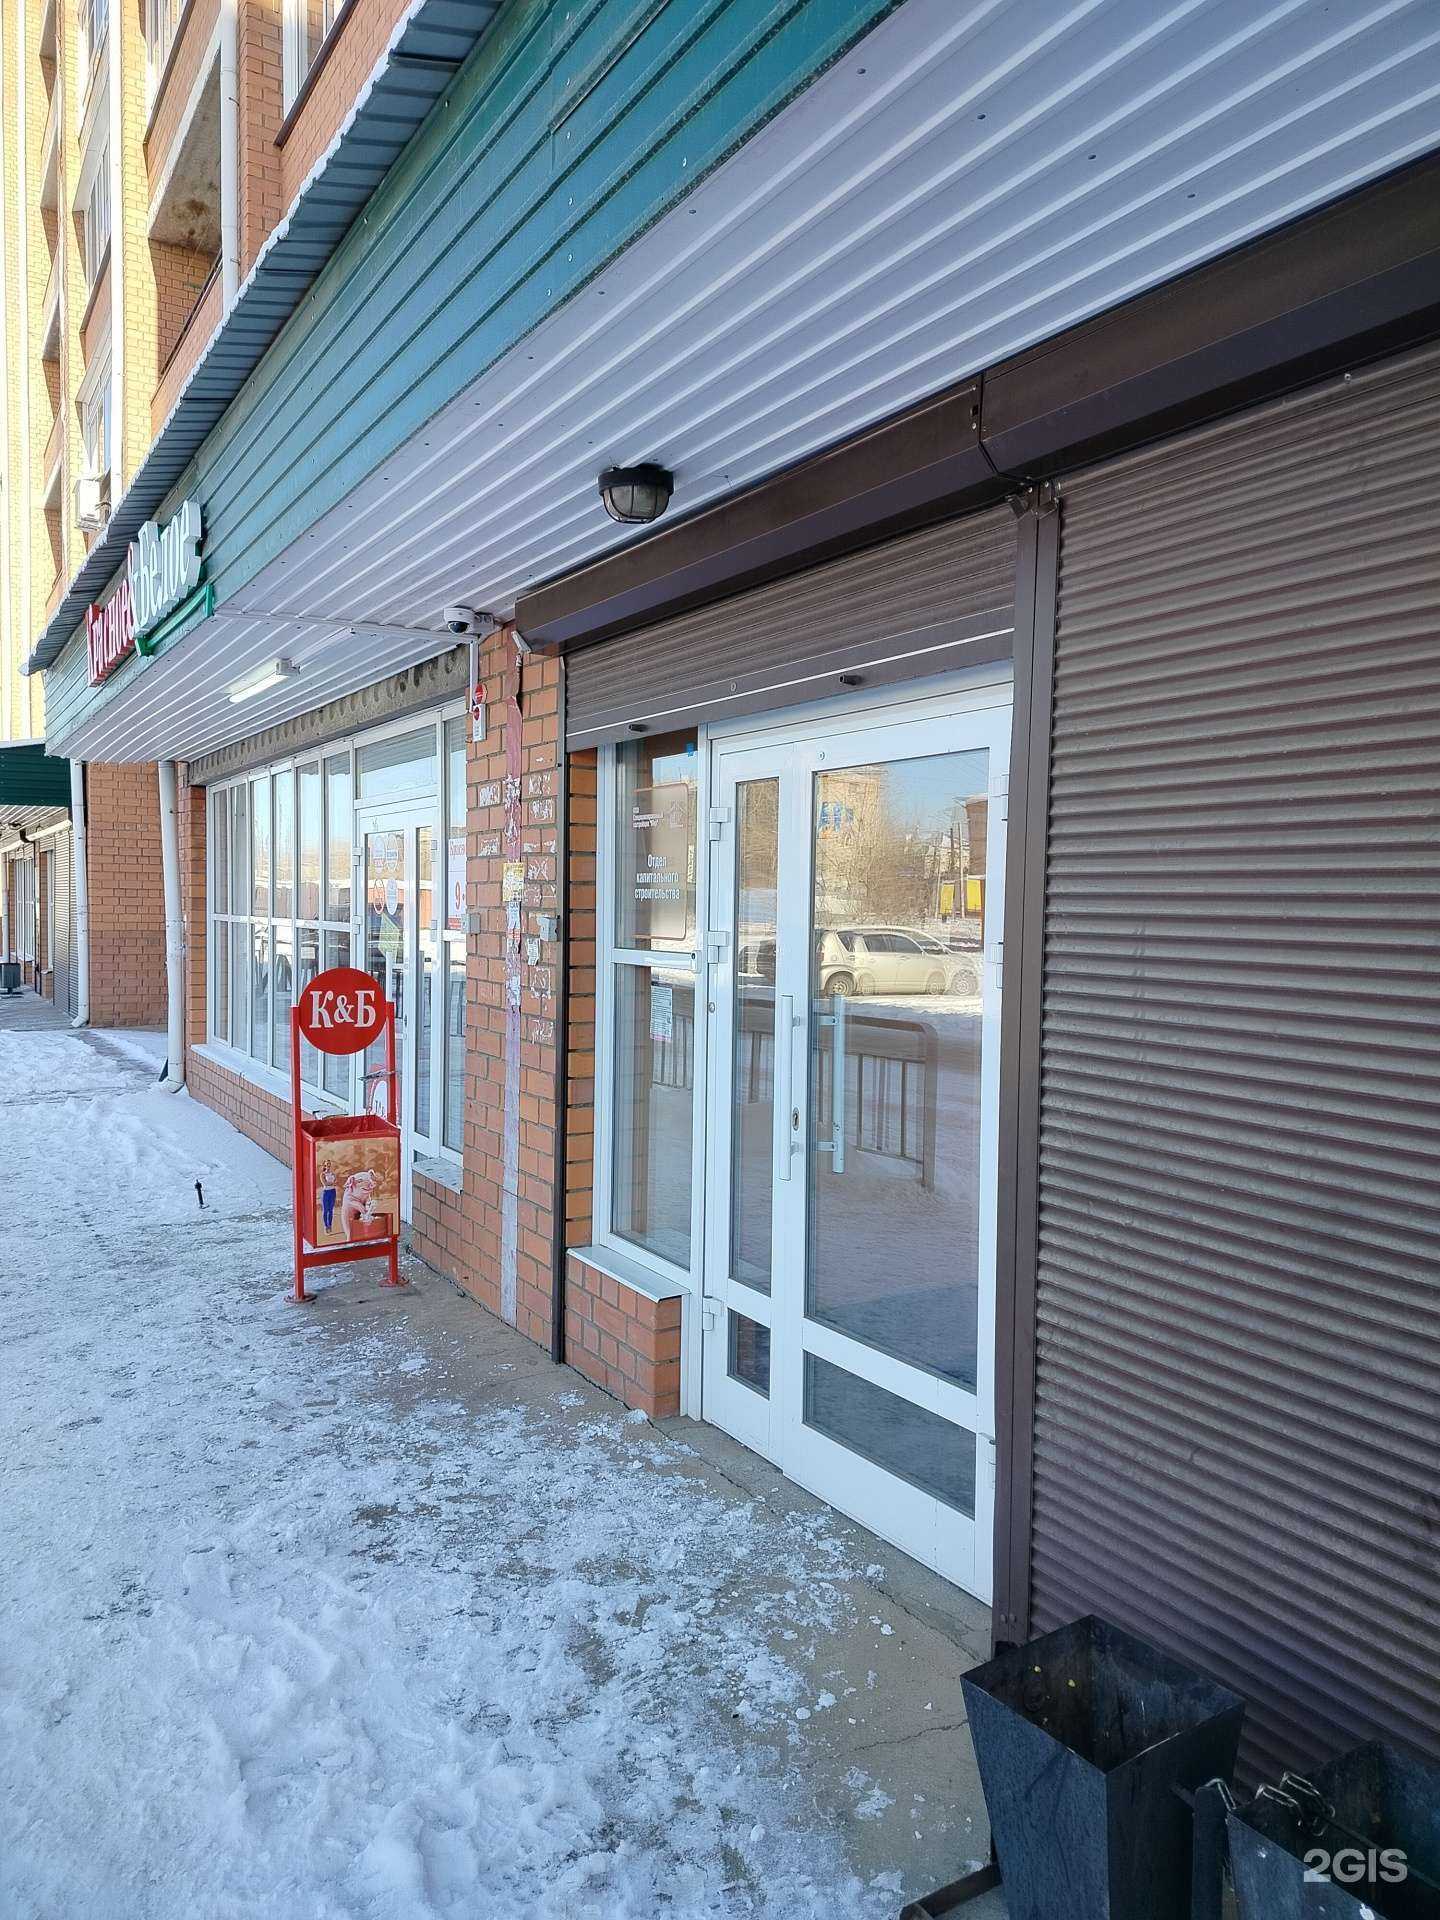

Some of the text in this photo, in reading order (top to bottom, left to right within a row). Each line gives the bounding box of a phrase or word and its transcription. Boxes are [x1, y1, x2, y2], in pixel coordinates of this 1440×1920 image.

[647, 854, 667, 869] Отдел
[636, 871, 679, 883] капитального
[634, 888, 680, 902] строительства
[309, 990, 376, 1029] К&Б
